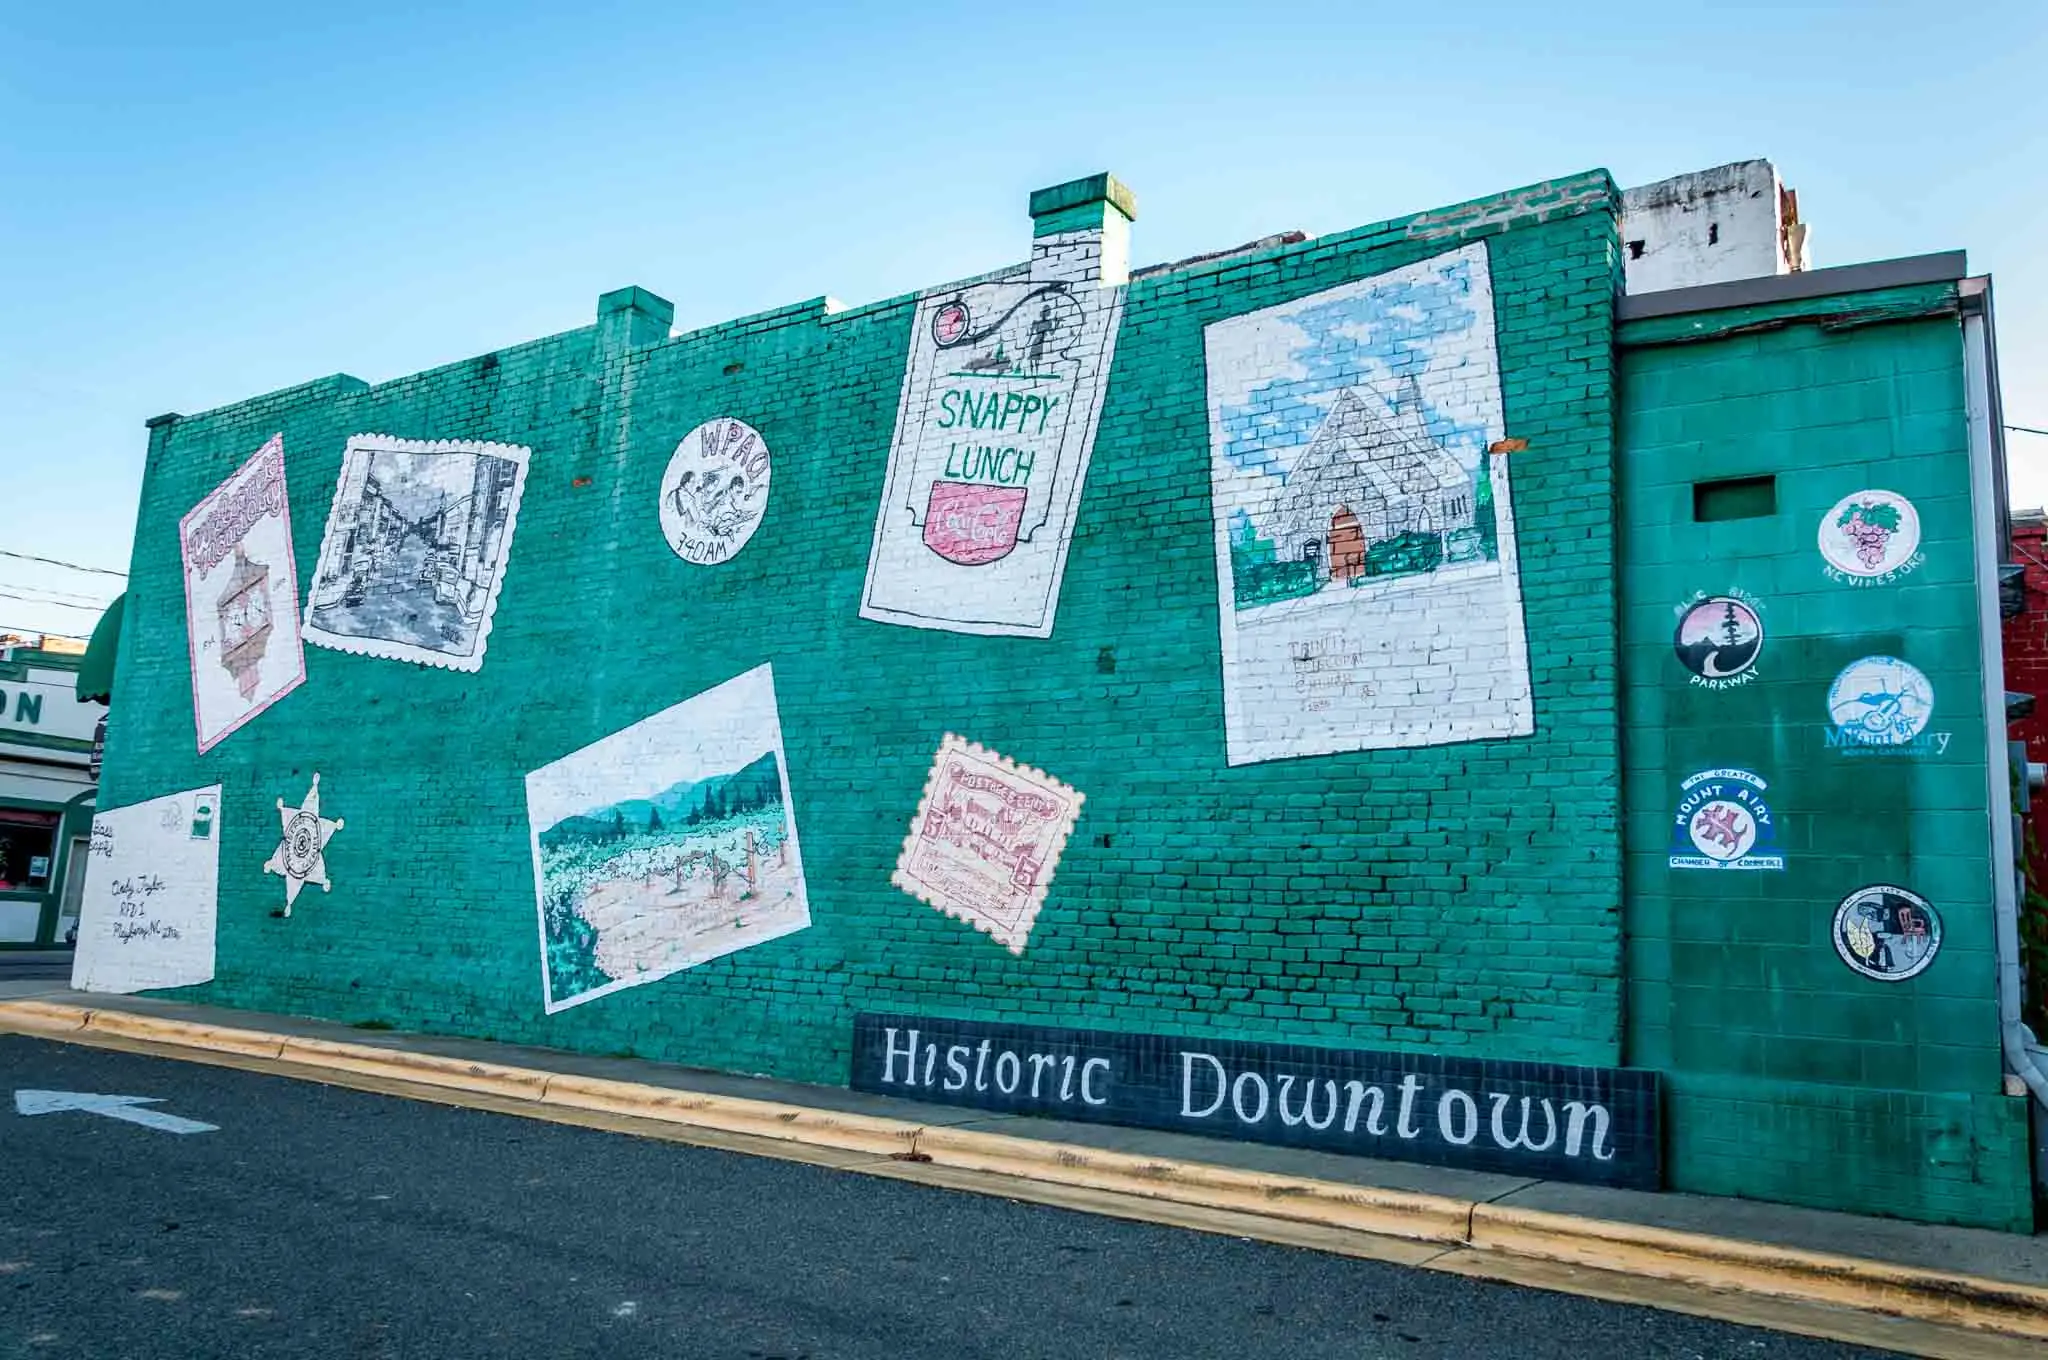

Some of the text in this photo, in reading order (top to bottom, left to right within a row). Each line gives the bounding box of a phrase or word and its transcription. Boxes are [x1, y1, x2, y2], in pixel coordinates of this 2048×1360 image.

[938, 389, 1060, 434] SNAPPY
[944, 443, 1036, 485] LUNCH
[1689, 666, 1759, 690] PARKWAY
[1714, 770, 1757, 783] GREATER
[1676, 785, 1771, 825] MOUNT AIRY
[881, 1027, 1616, 1161] Historic Downtown
